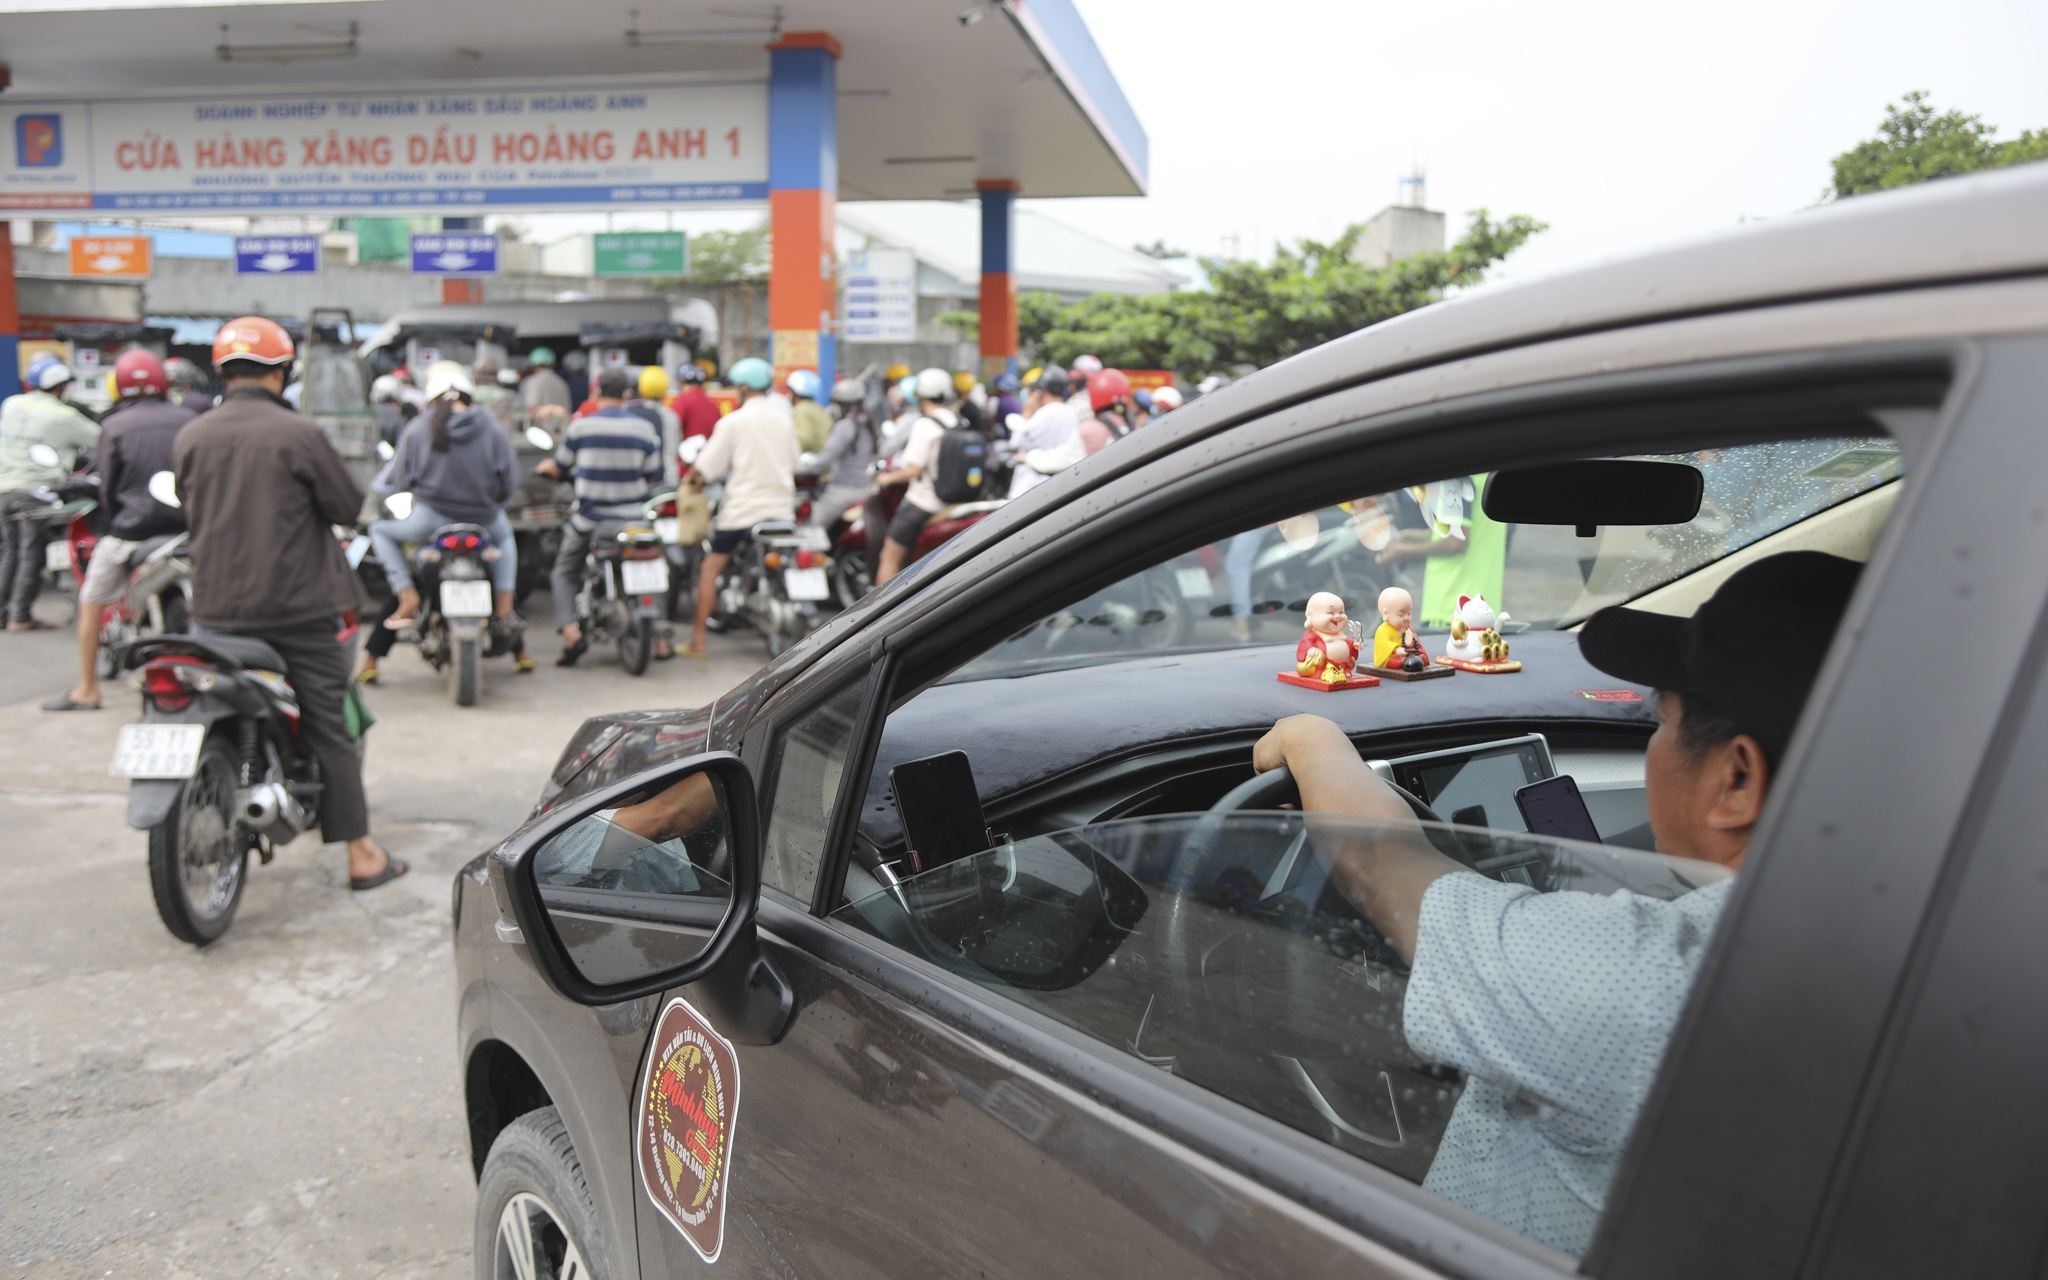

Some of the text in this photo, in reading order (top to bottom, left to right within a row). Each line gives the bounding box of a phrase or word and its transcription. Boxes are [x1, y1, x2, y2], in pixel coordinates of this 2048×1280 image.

[606, 93, 648, 111] ANH
[115, 121, 742, 171] CỬA HÀNG XĂNG DẦU HOÀNG ANH 1
[711, 1058, 722, 1094] MINH
